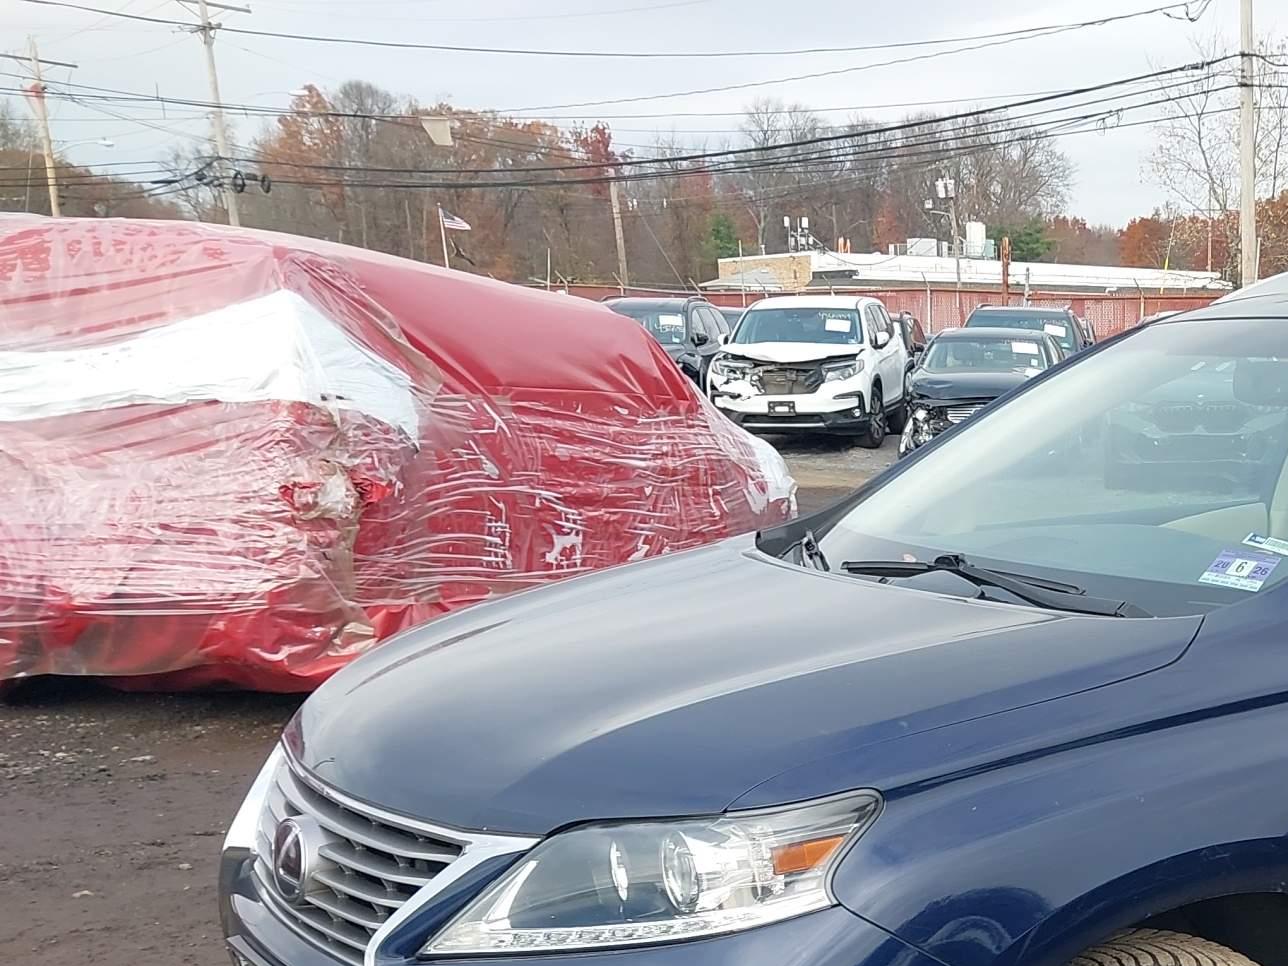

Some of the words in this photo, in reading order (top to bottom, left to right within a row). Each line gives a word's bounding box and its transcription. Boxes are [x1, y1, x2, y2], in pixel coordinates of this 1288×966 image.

[1213, 559, 1231, 569] 20
[1235, 561, 1248, 573] 6
[1252, 566, 1270, 576] 26
